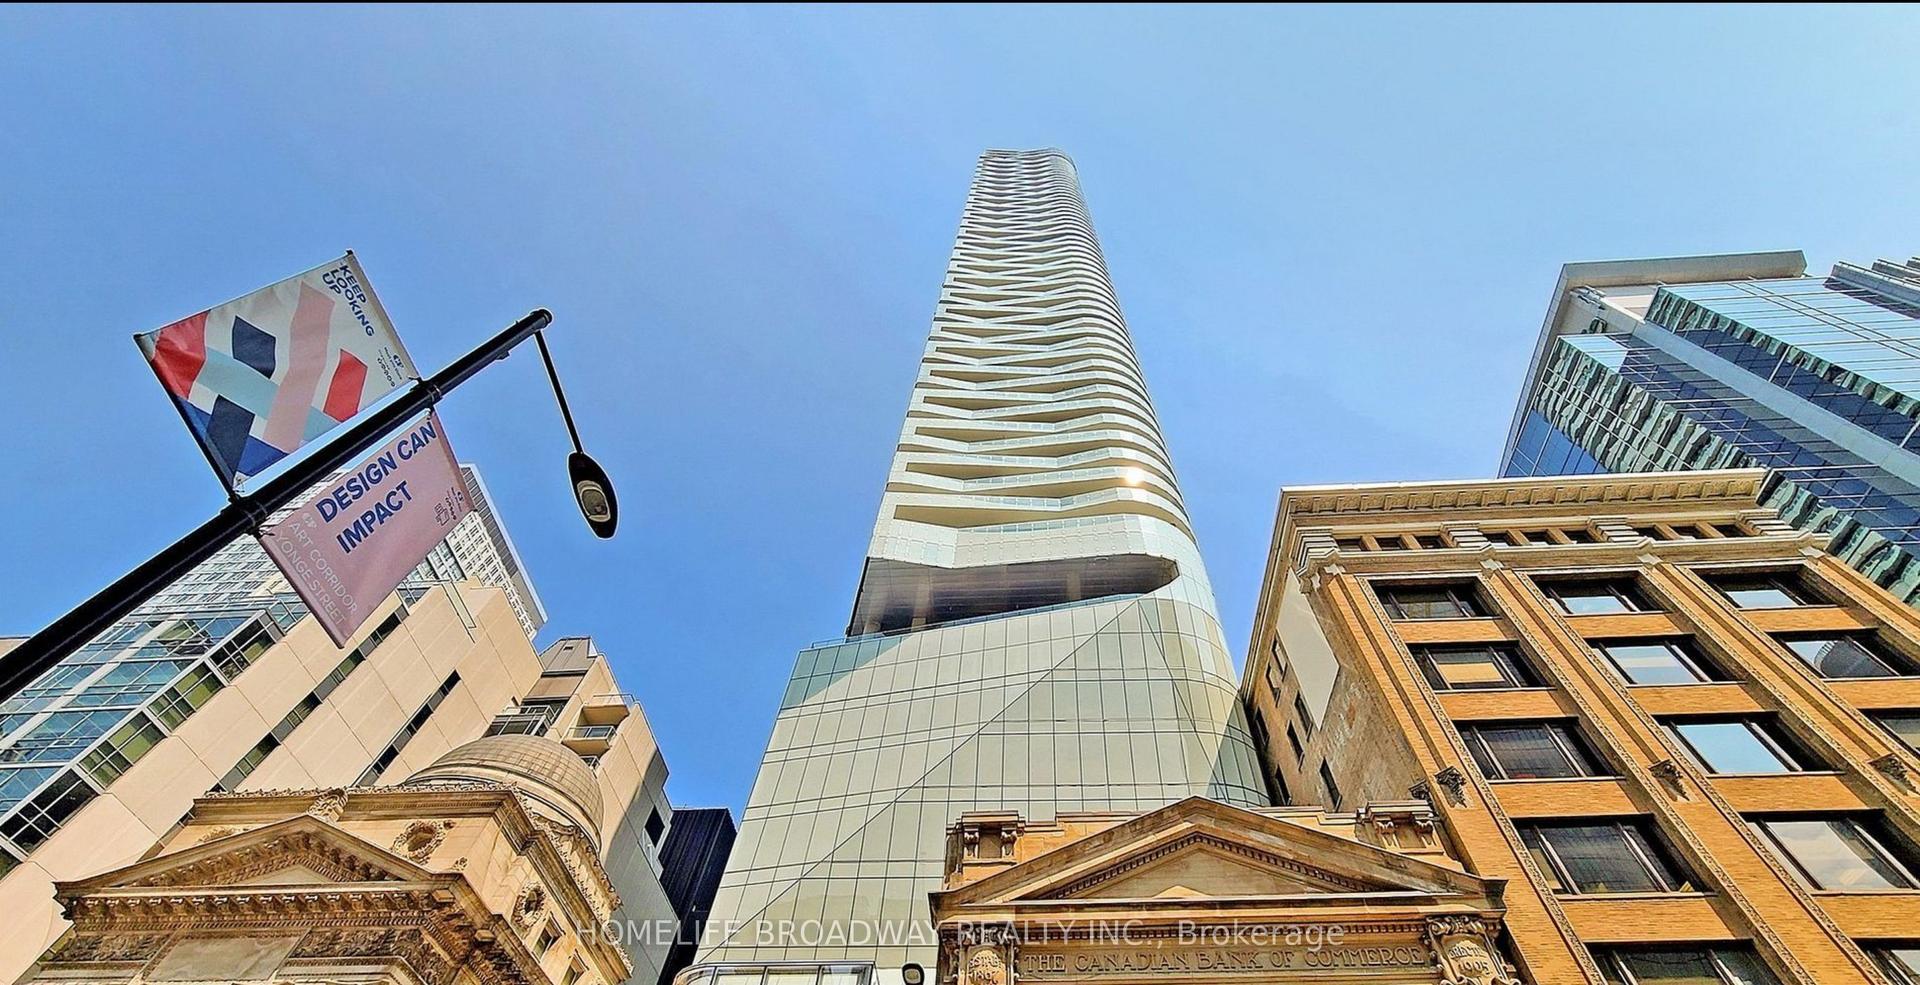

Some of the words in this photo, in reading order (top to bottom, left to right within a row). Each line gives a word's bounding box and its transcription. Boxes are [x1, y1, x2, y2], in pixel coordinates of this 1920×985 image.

[322, 272, 341, 295] UP
[330, 269, 375, 336] LOOKING
[339, 265, 366, 303] KEEP
[315, 451, 398, 523] DESIGN
[397, 421, 437, 460] CAN
[336, 480, 412, 554] IMPACT
[276, 530, 313, 580] YONGE
[309, 579, 345, 625] STREET
[288, 522, 313, 548] ART
[310, 549, 358, 614] CORRIDOR
[1024, 954, 1066, 973] THE
[1074, 952, 1190, 972] CANADIAN
[1197, 951, 1263, 970] BANK
[1270, 950, 1295, 968] OF
[1304, 947, 1425, 967] COMMERCE
